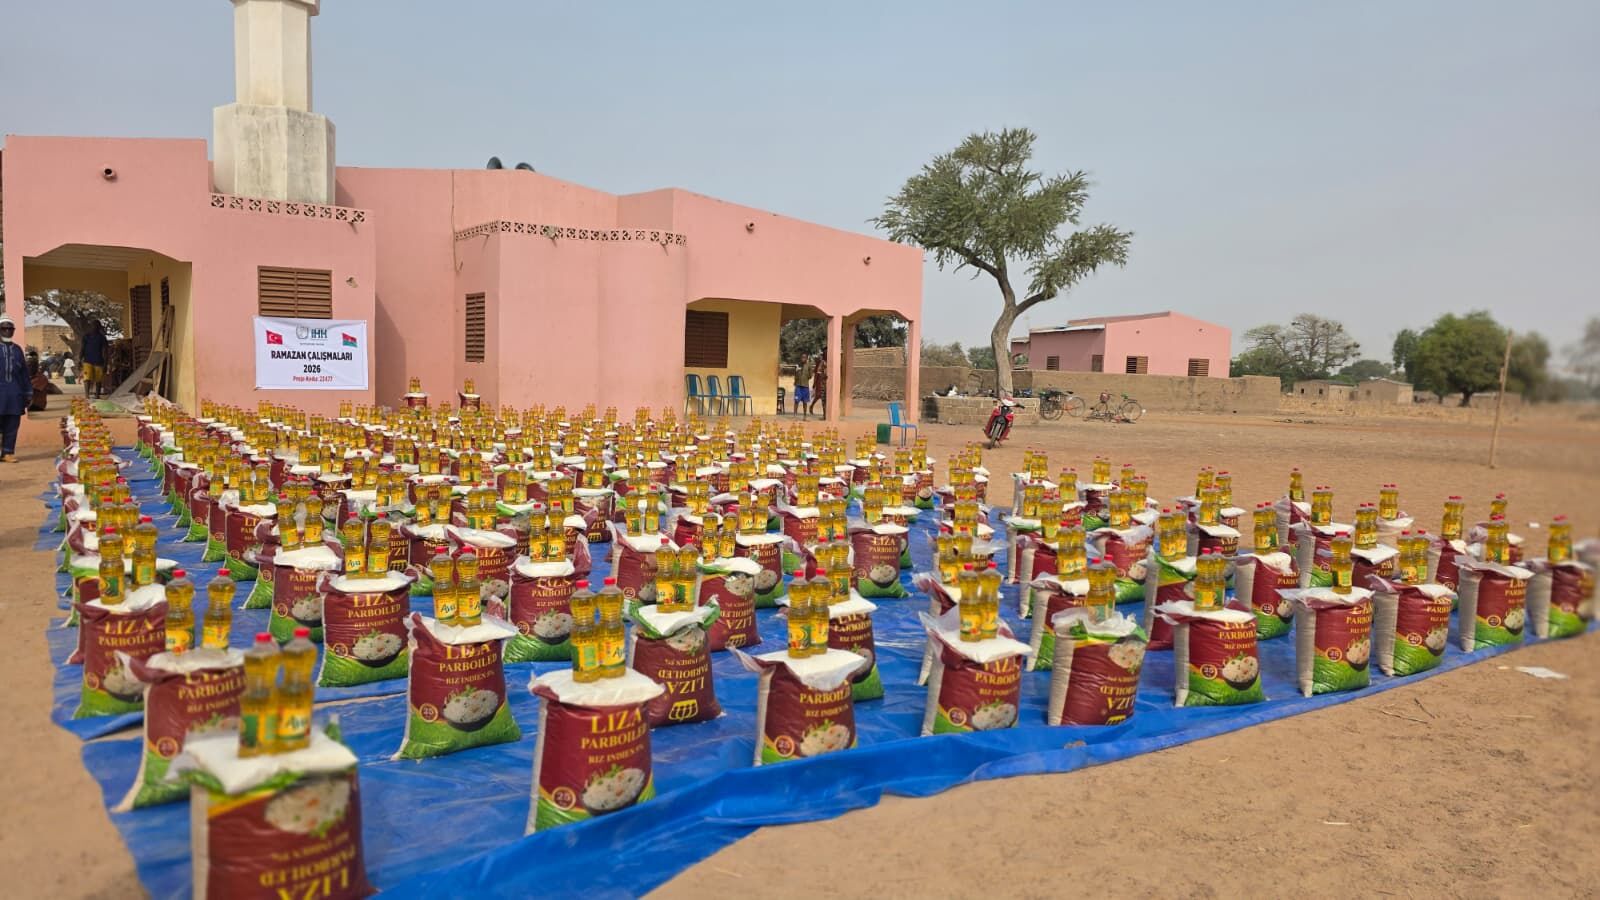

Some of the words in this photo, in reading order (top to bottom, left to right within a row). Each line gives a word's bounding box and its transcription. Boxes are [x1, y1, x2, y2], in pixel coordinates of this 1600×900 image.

[271, 350, 306, 360] RAMAZAN
[308, 351, 353, 362] ÇALIŞMALARI
[303, 364, 321, 373] 2026
[353, 592, 395, 608] LIZA
[104, 619, 154, 634] LIZA
[439, 652, 498, 672] PARBOILED
[666, 677, 706, 694] LIZA
[591, 707, 642, 734] LIZA
[588, 754, 604, 764] RIZ
